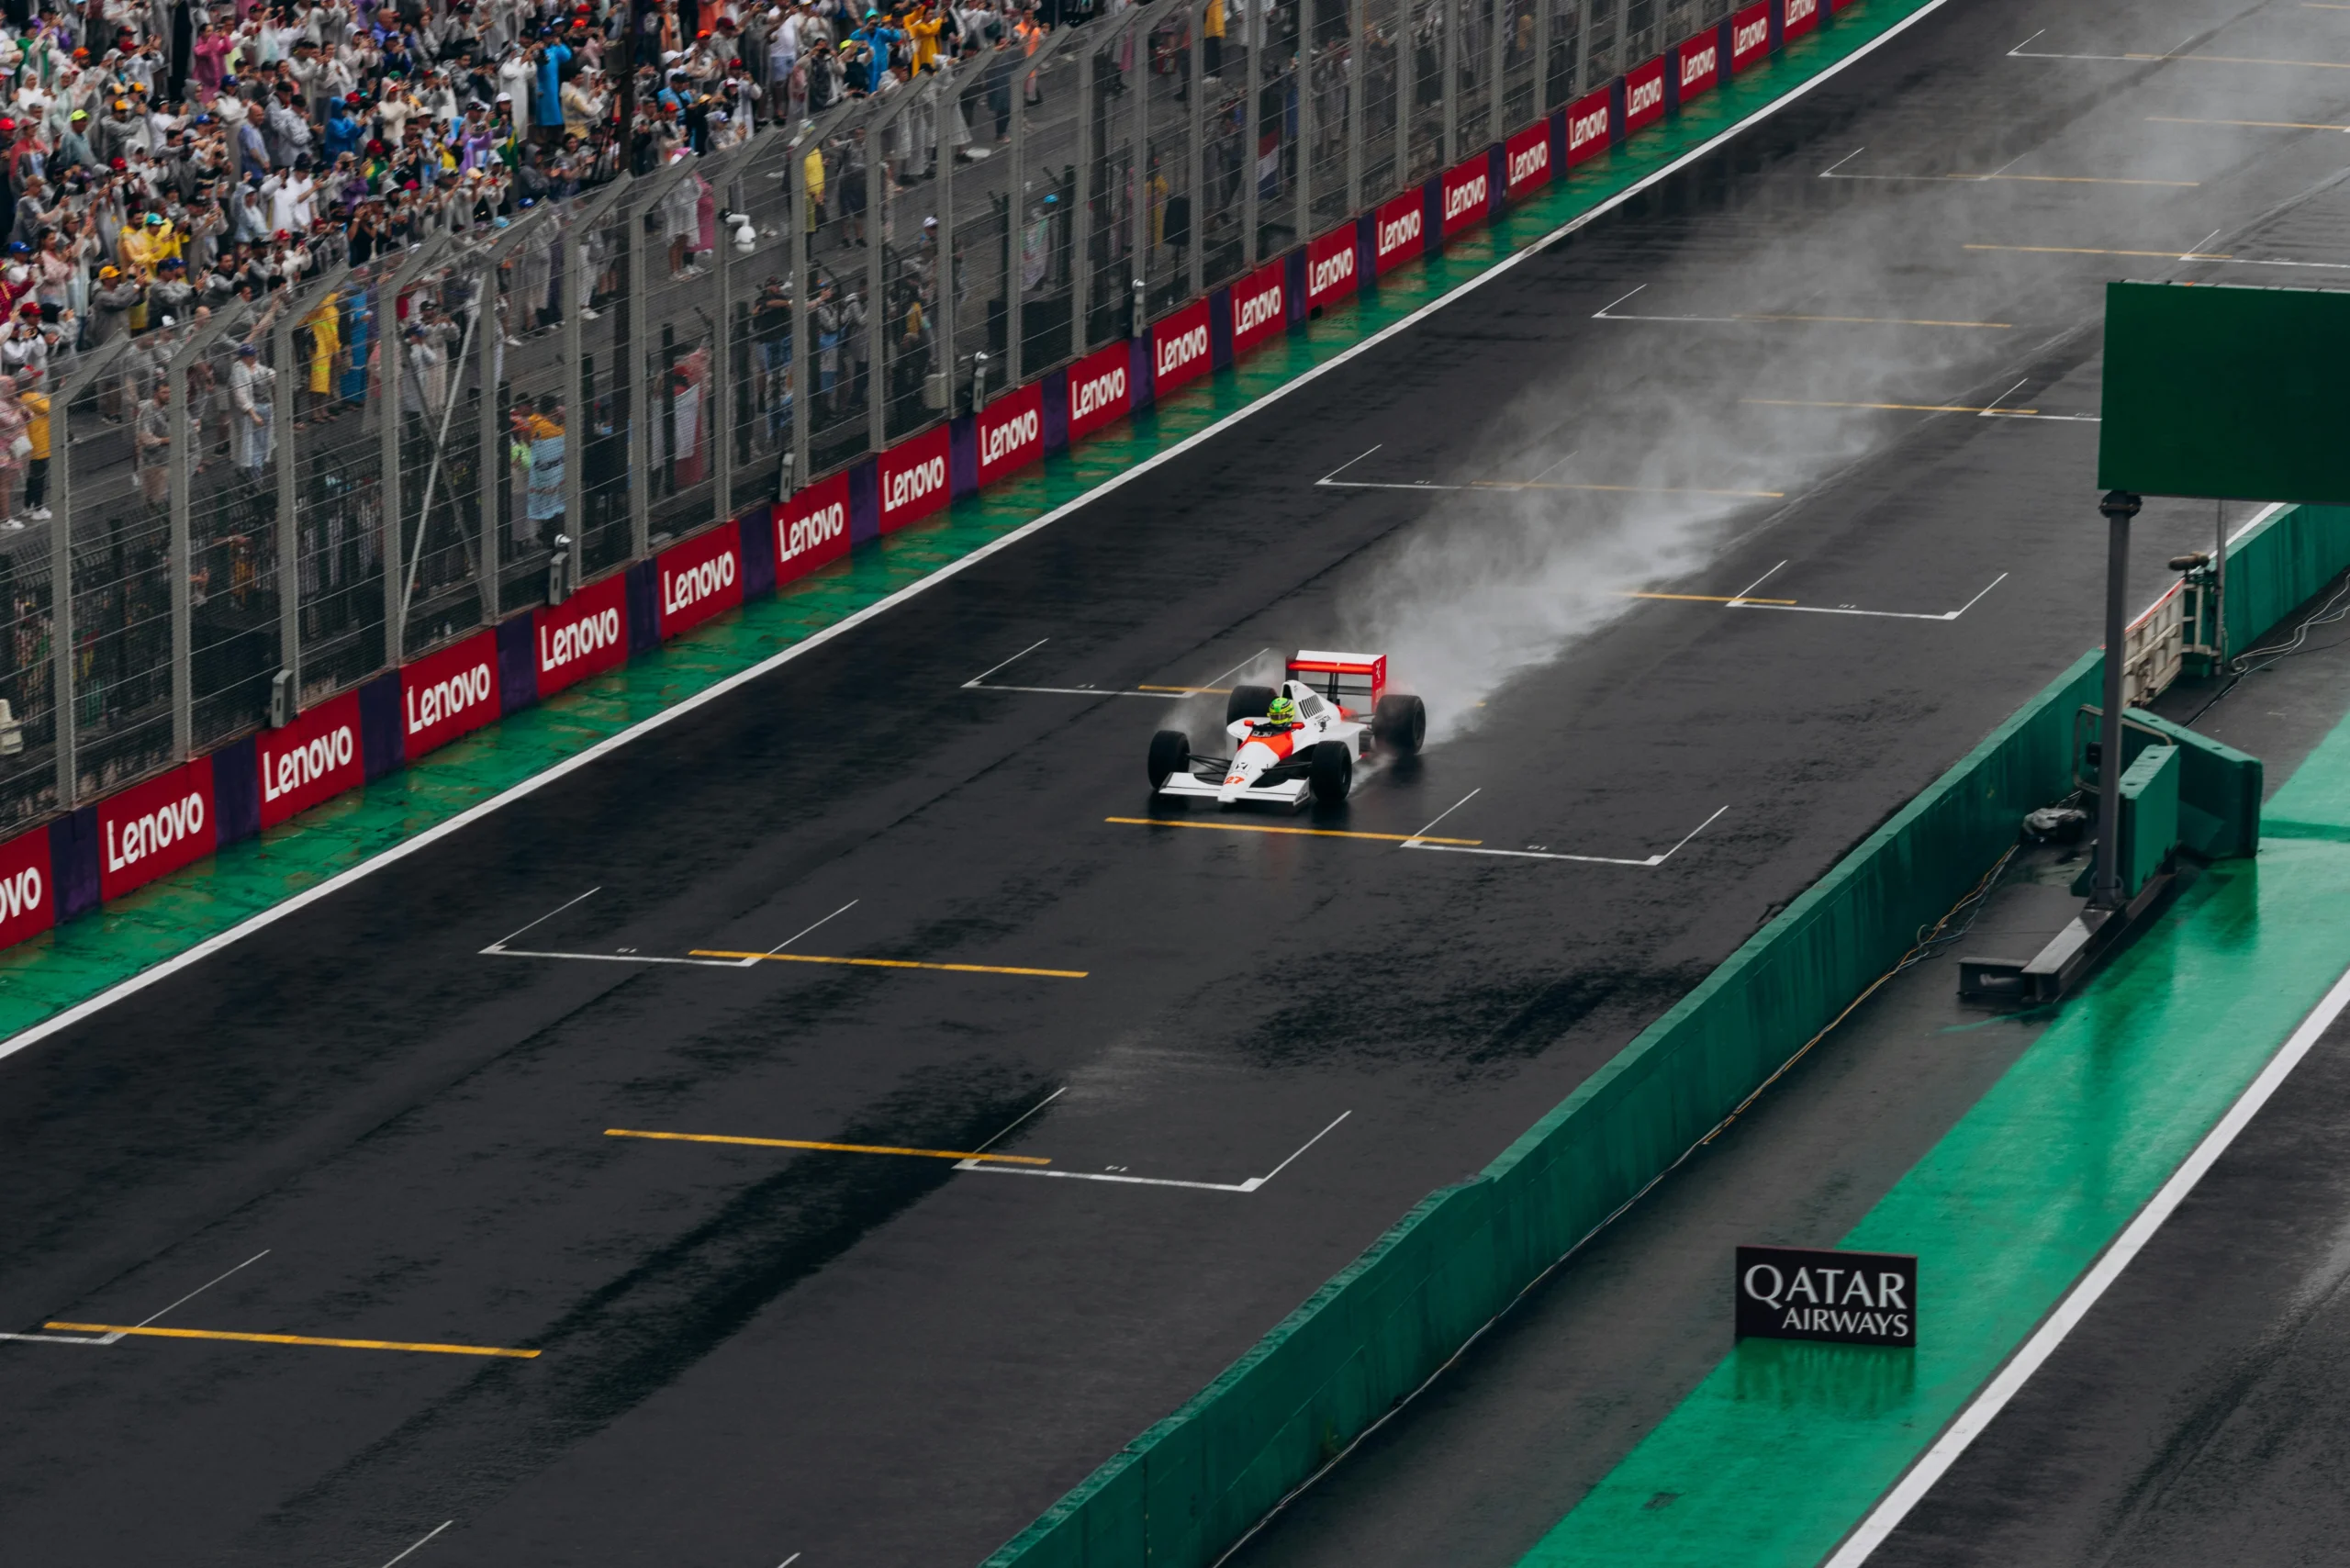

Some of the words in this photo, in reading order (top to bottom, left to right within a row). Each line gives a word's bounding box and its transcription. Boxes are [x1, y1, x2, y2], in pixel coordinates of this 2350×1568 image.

[1627, 76, 1662, 118] Lenovo
[1569, 106, 1607, 151] Lenovo
[1508, 140, 1548, 186] Lenovo
[1445, 174, 1486, 221] Lenovo
[1378, 209, 1421, 256] Lenovo
[1308, 247, 1354, 297] Lenovo
[1235, 285, 1281, 336] Lenovo
[1157, 324, 1208, 377] Lenovo
[1071, 366, 1125, 420] Lenovo
[980, 409, 1038, 466] Lenovo
[883, 455, 945, 512] Lenovo
[778, 501, 844, 563] Lenovo
[664, 551, 735, 616] Lenovo
[540, 607, 620, 672] Lenovo
[407, 663, 491, 734] Lenovo
[263, 725, 353, 802] Lenovo
[1224, 776, 1245, 785] 27
[107, 791, 205, 873] Lenovo
[1745, 1264, 1908, 1310] QATAR
[1782, 1307, 1909, 1338] AIRWAYS
